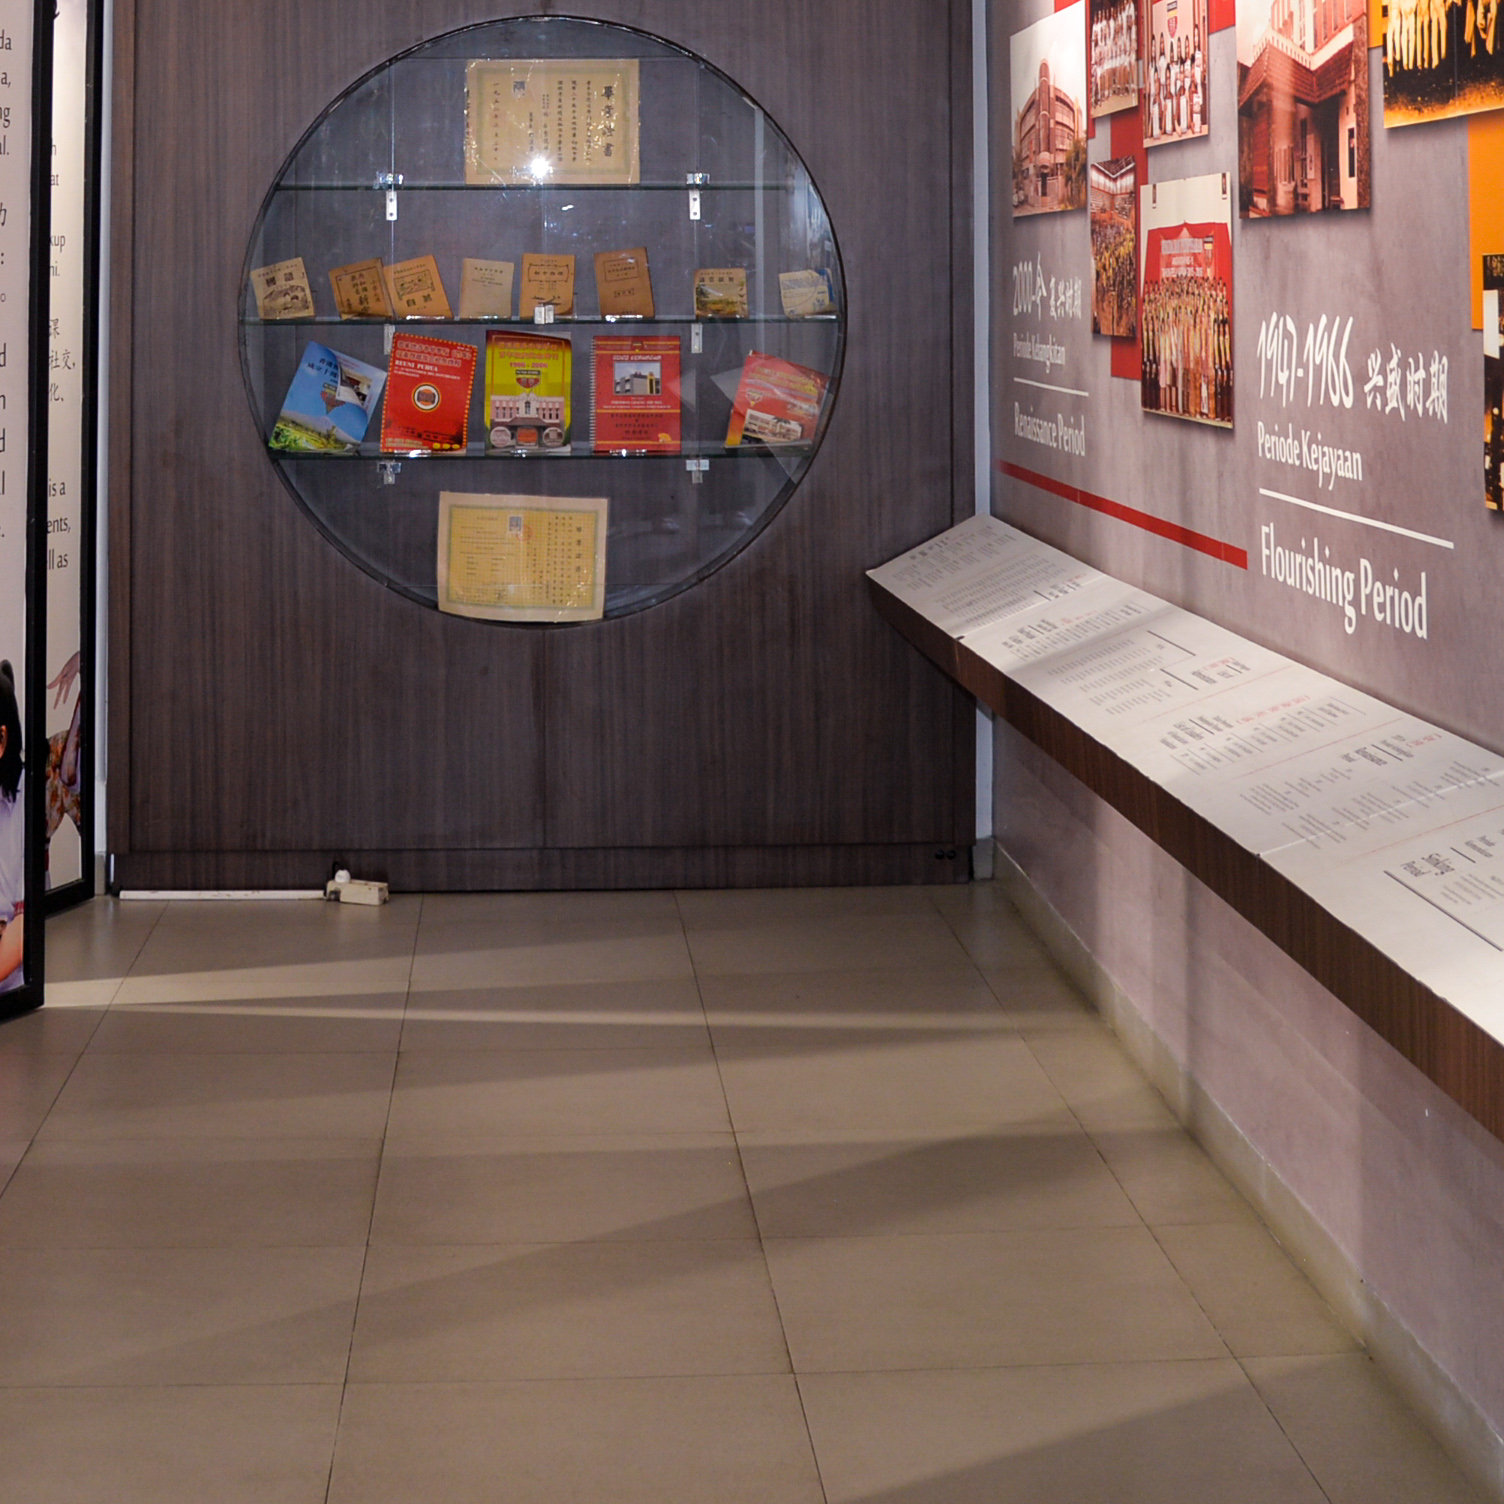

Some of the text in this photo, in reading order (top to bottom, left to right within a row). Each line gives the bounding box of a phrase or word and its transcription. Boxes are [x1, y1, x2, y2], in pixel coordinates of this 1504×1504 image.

[1257, 311, 1354, 409] 1947-1966
[1014, 402, 1086, 457] Renaissance Period
[1257, 421, 1363, 491] Periode Kejayaan
[1261, 522, 1356, 635] Flourishing
[1360, 558, 1428, 640] Period
